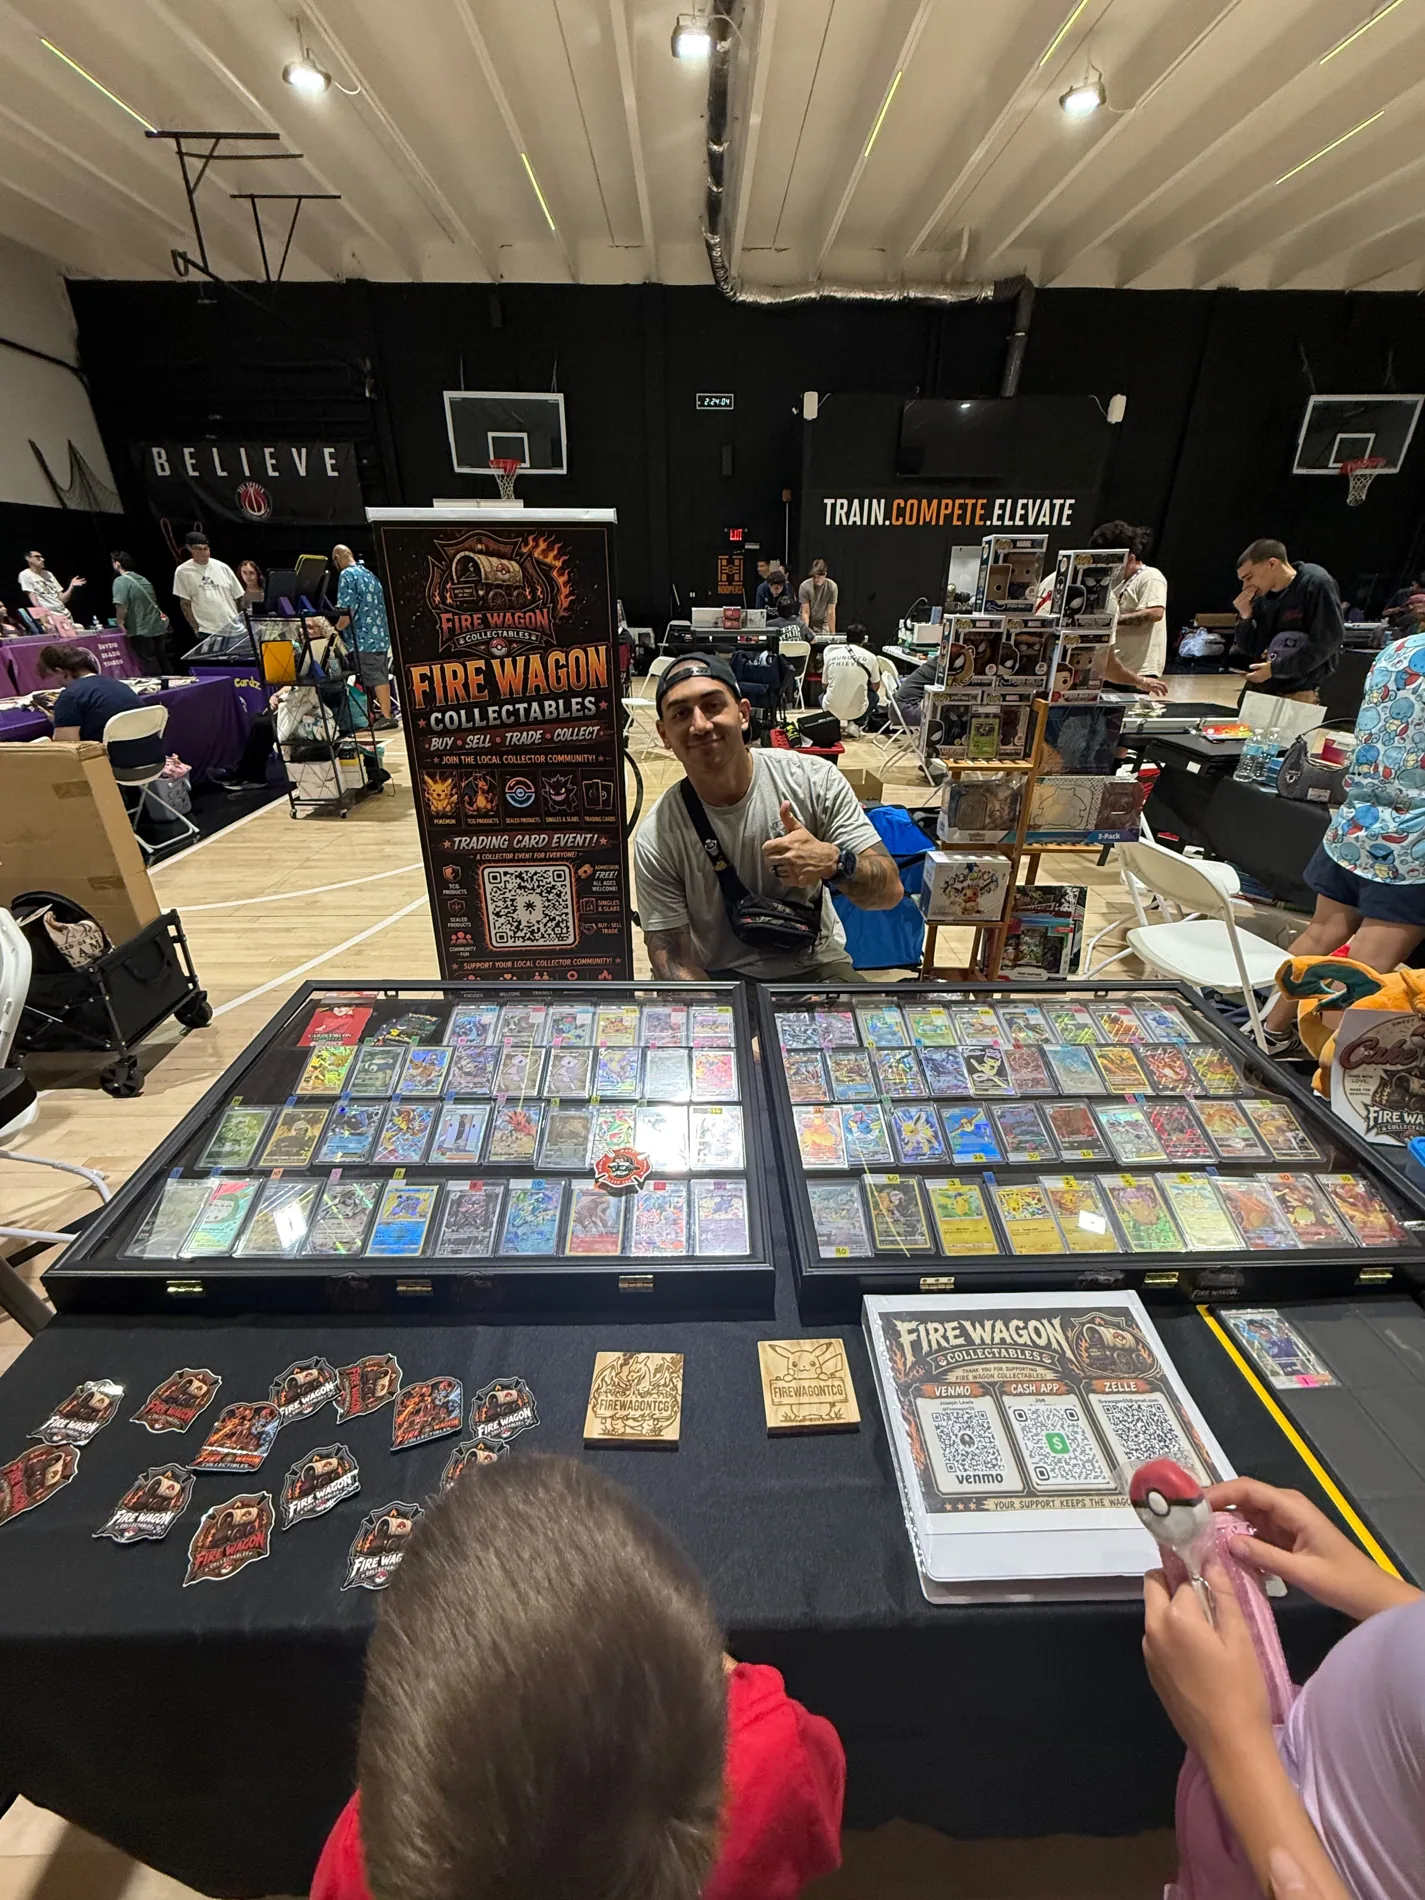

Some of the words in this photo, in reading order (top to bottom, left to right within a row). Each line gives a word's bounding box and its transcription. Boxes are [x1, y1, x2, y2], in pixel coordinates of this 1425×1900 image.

[152, 447, 339, 477] BELIEVE
[730, 529, 743, 541] EXIT
[440, 612, 484, 638] FIRE
[487, 609, 549, 630] WAGON
[466, 630, 530, 644] COLLECTABLES
[409, 659, 489, 710] FIRE
[490, 645, 610, 700] WAGON
[430, 696, 597, 731] COLLECTABLES
[430, 738, 454, 751] BUY
[465, 735, 491, 749] SELL
[505, 731, 543, 746] TRADE
[553, 726, 600, 742] COLLECT
[441, 755, 460, 764] JOIN
[461, 755, 476, 764] THE
[477, 755, 501, 764] LOCAL
[503, 755, 546, 763] COLLECTOR
[547, 754, 596, 763] COMMUNITY!
[452, 835, 509, 850] TRADING
[513, 834, 548, 848] CARD
[551, 833, 599, 848] EVENT!
[1097, 832, 1121, 841] 3-Pack
[514, 852, 533, 860] EVENT
[546, 851, 578, 859] EVERYONE!
[595, 870, 618, 880] FREE!
[463, 962, 493, 970] SUPPORT
[494, 961, 513, 969] YOUR
[514, 960, 534, 968] LOCAL
[535, 959, 571, 967] COLLECTOR
[572, 957, 613, 966] COMMUNITY!
[1368, 1105, 1402, 1129] FIRE
[893, 1318, 961, 1372] FIRE
[961, 1316, 1081, 1367] WAGON
[946, 1348, 1040, 1363] COLLECTABLES
[772, 1384, 844, 1398] FIREWAGONTCG
[934, 1386, 971, 1396] VENMO
[1011, 1384, 1036, 1394] CASH
[1039, 1383, 1059, 1393] APP
[1104, 1381, 1138, 1392] ZELLE
[279, 1401, 302, 1420] FIRE
[301, 1382, 334, 1403] WAGON
[598, 1398, 670, 1413] FIREWAGONTCG
[144, 1401, 167, 1416] FIRE
[166, 1405, 197, 1421] WAGON
[42, 1415, 66, 1431] FIRE
[65, 1418, 100, 1434] WAGON
[477, 1422, 500, 1438] FIRE
[499, 1407, 532, 1426] WAGON
[956, 1472, 1004, 1485] venmo
[288, 1499, 315, 1519] FIRE
[315, 1476, 354, 1500] WAGON
[993, 1500, 1016, 1510] YOUR
[1019, 1499, 1056, 1509] SUPPORT
[1059, 1498, 1086, 1508] KEEPS
[1089, 1498, 1106, 1507] THE
[1108, 1497, 1131, 1507] WAG
[108, 1510, 139, 1526] FIRE
[138, 1510, 175, 1525] WAGON
[194, 1547, 226, 1570] FIRE
[225, 1532, 266, 1556] WAGON
[350, 1554, 380, 1579] FIRE
[381, 1552, 403, 1568] WAG
